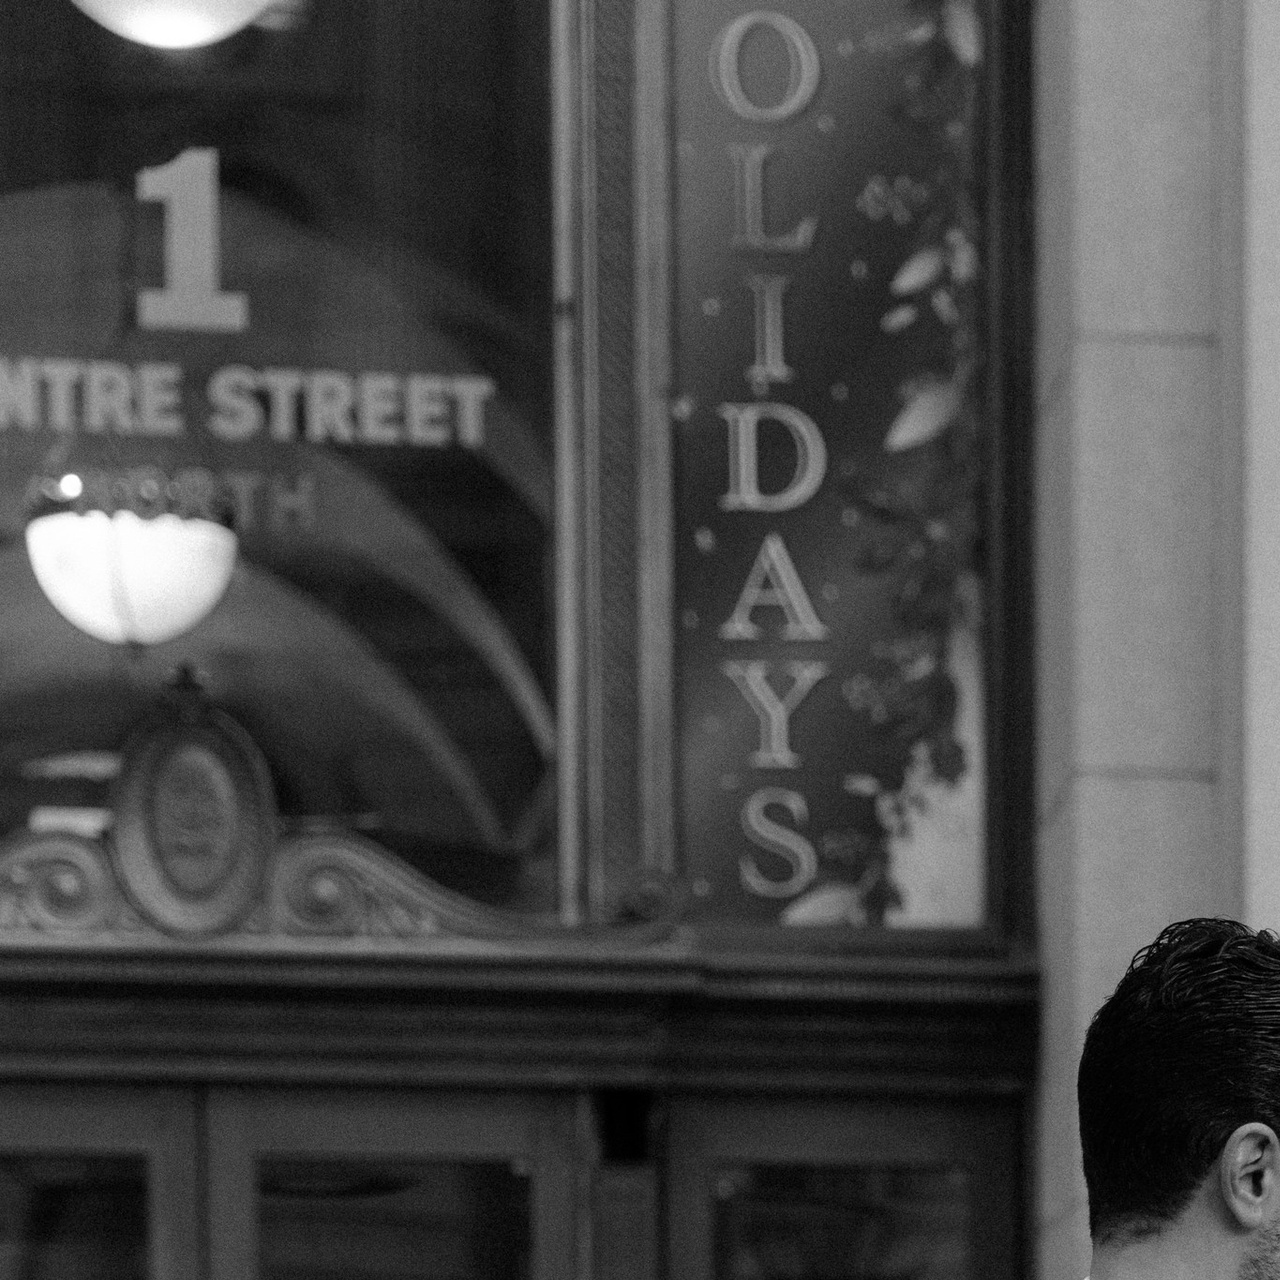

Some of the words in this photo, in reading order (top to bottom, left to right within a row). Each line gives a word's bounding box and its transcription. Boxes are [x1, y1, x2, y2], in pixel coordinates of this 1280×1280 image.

[135, 146, 250, 333] 1
[206, 364, 496, 448] STREET
[709, 9, 829, 899] OLIDAYS
